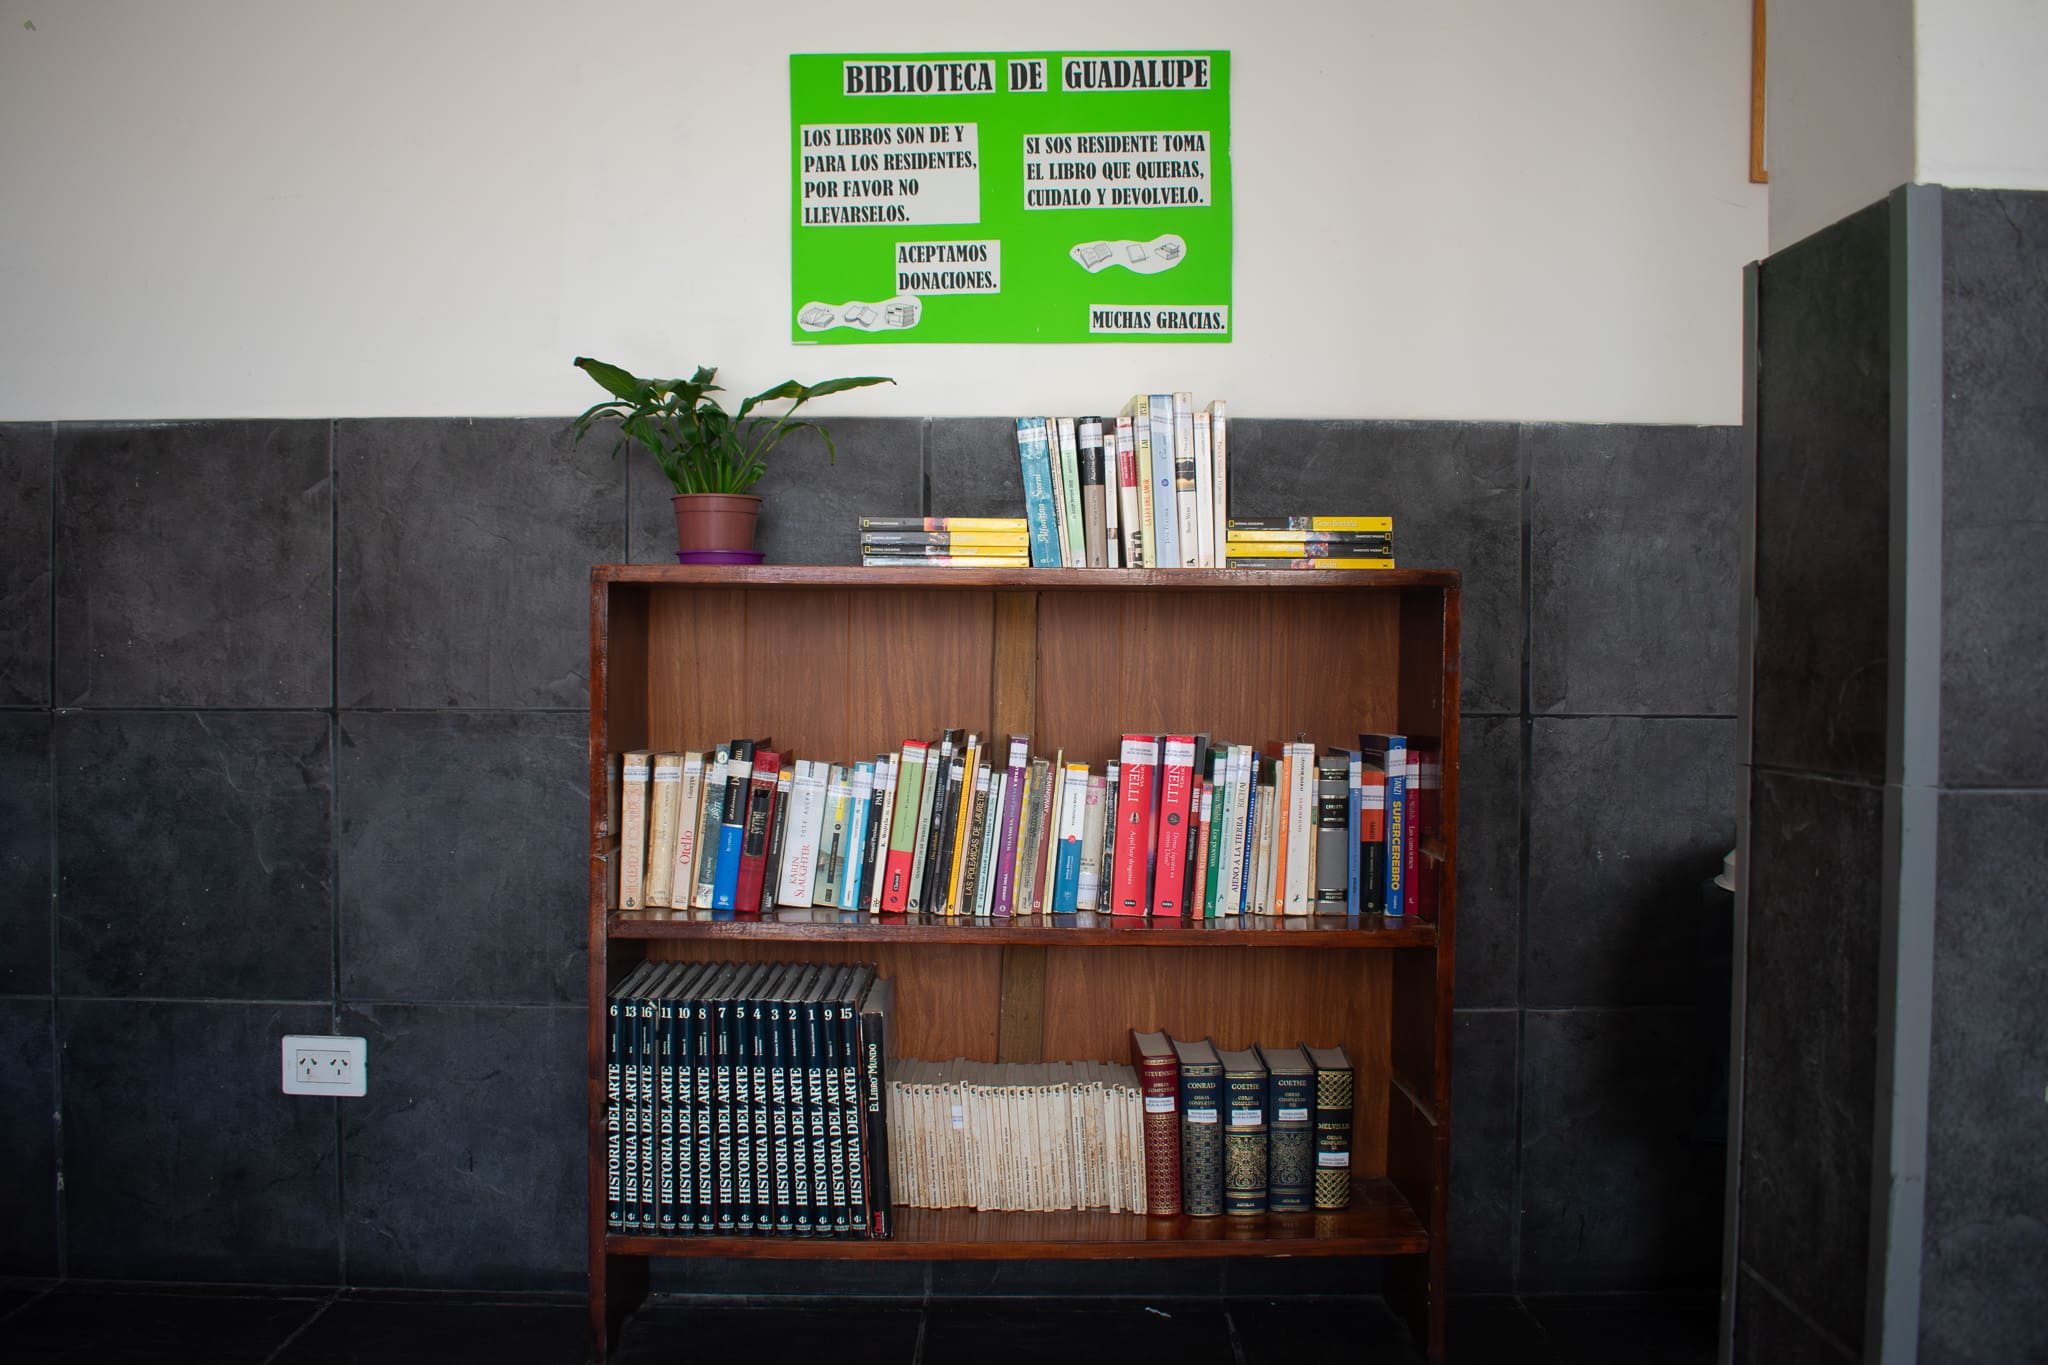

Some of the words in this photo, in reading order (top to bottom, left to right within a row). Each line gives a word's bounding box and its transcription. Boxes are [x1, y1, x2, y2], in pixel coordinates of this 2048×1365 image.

[846, 63, 992, 93] BIBLIOTECA
[1010, 62, 1042, 90] DE
[1065, 60, 1207, 88] GUADALUPE
[805, 130, 830, 146] LOS
[837, 128, 891, 145] LIBROS
[897, 127, 924, 144] SON
[930, 126, 949, 142] DE
[955, 126, 963, 142] Y
[1027, 138, 1040, 154] SI
[1046, 137, 1071, 153] SOS
[1078, 136, 1157, 153] RESIDENTE
[1163, 135, 1205, 152] TOMA
[805, 155, 845, 172] PARA
[852, 155, 878, 171] LOS
[884, 151, 976, 170] RESIDENTES,
[1028, 164, 1043, 180] EL
[1050, 163, 1096, 179] LIBRO
[1103, 162, 1130, 180] QUE
[1136, 161, 1203, 180] QUIERAS,
[805, 182, 837, 198] POR
[844, 180, 893, 197] FAVOR
[900, 179, 918, 195] NO
[1028, 189, 1090, 206] CUIDALO
[1097, 189, 1105, 204] Y
[1112, 187, 1203, 204] DEVOLVELO.
[806, 205, 909, 223] LLEVARSELOS.
[899, 245, 986, 263] ACEPTAMOS
[899, 271, 996, 289] DONACIONES.
[1093, 311, 1150, 328] MUCHAS
[1157, 312, 1224, 329] GRACIAS.
[1043, 772, 1052, 812] HEMINGWAY
[975, 791, 986, 824] JAURETC
[973, 825, 980, 836] DE
[1234, 816, 1243, 843] TIERRA
[680, 830, 693, 864] Otello
[968, 838, 979, 880] POLEMICAS
[1234, 846, 1241, 856] LA
[1392, 801, 1401, 890] SUPERCEREBRO
[790, 856, 799, 884] KARIN
[794, 845, 810, 897] SLAUGHTER
[1232, 867, 1240, 892] AJENO
[966, 882, 974, 896] LAS
[610, 1006, 618, 1016] 6
[626, 1006, 636, 1017] 13
[642, 1006, 652, 1018] 16
[662, 1008, 672, 1018] 11
[678, 1008, 690, 1018] 10
[698, 1008, 706, 1019] 8
[718, 1008, 726, 1018] 7
[736, 1008, 744, 1018] 5
[753, 1008, 760, 1019] 4
[771, 1009, 779, 1020] 3
[788, 1009, 796, 1020] 2
[809, 1010, 814, 1020] 1
[824, 1010, 832, 1020] 9
[840, 1008, 852, 1019] 15
[867, 1043, 877, 1074] MUNDO
[609, 1064, 619, 1101] ARTE
[626, 1065, 636, 1102] ARTE
[640, 1066, 652, 1103] ARTE
[661, 1066, 672, 1103] ARTE
[679, 1066, 690, 1103] ARTE
[698, 1067, 709, 1104] ARTE
[718, 1066, 729, 1103] ARTE
[736, 1066, 748, 1103] ARTE
[754, 1067, 766, 1104] ARTE
[772, 1068, 785, 1104] ARTE
[790, 1068, 803, 1105] ARTE
[809, 1068, 822, 1105] ARTE
[826, 1068, 839, 1105] ARTE
[844, 1067, 856, 1104] ARTE
[868, 1077, 878, 1100] LIBRO
[609, 1103, 619, 1131] DEL
[626, 1104, 636, 1132] DEL
[642, 1105, 652, 1133] DEL
[662, 1106, 672, 1133] DEL
[680, 1105, 690, 1133] DEL
[699, 1106, 710, 1134] DEL
[719, 1105, 730, 1133] DEL
[737, 1105, 748, 1133] DEL
[755, 1106, 767, 1134] DEL
[847, 1106, 858, 1134] DEL
[869, 1101, 878, 1111] EL
[774, 1107, 786, 1134] DEL
[792, 1107, 804, 1135] DEL
[812, 1107, 823, 1136] DEL
[829, 1107, 841, 1135] DEL
[609, 1134, 619, 1201] HISTORIA
[626, 1136, 637, 1202] HISTORIA
[642, 1136, 652, 1203] HISTORIA
[662, 1137, 672, 1203] HISTORIA
[680, 1137, 691, 1203] HISTORIA
[699, 1137, 711, 1204] HISTORIA
[720, 1136, 731, 1203] HISTORIA
[738, 1136, 750, 1203] HISTORIA
[756, 1138, 769, 1204] HISTORIA
[776, 1138, 789, 1204] HISTORIA
[794, 1138, 807, 1205] HISTORIA
[813, 1138, 827, 1205] HISTORIA
[831, 1138, 845, 1205] HISTORIA
[848, 1137, 862, 1204] HISTORIA
